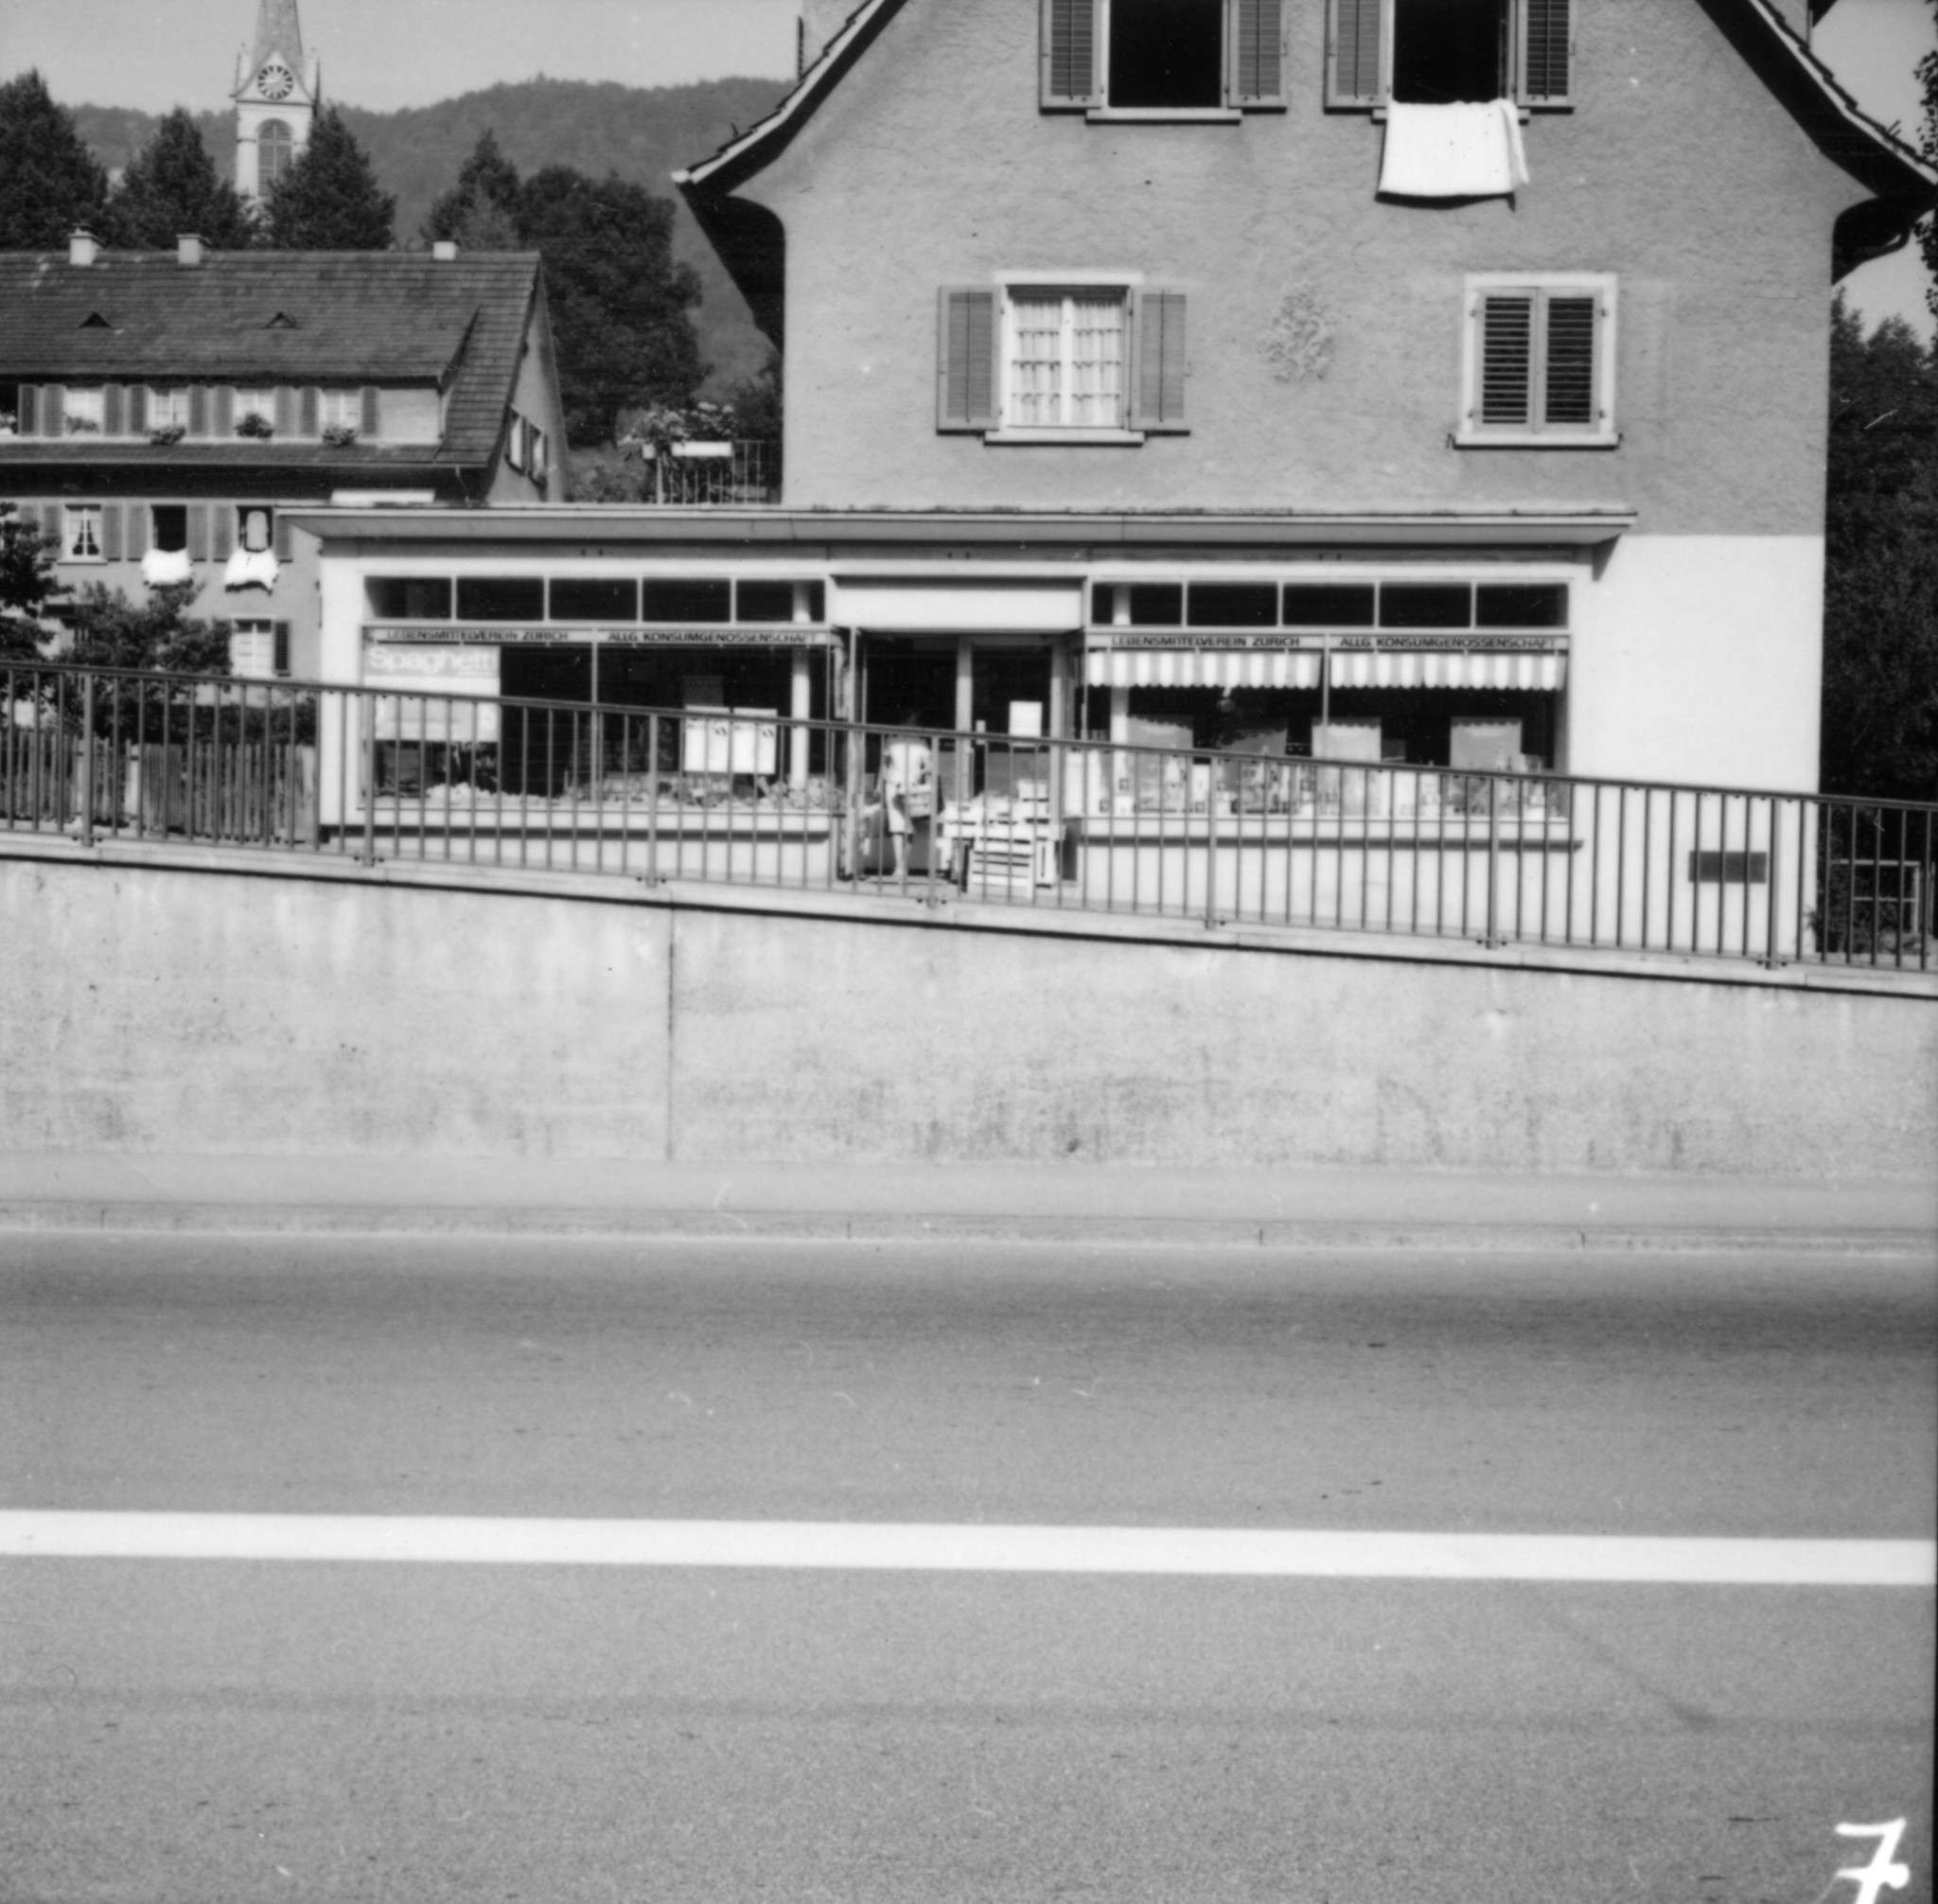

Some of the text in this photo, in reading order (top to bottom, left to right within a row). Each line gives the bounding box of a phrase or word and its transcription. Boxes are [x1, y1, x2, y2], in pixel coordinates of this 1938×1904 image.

[387, 628, 518, 641] LEBENSMITTELVEREIN
[643, 631, 816, 643] KONSUMGENOSSENSCHAFT
[1112, 635, 1246, 647] LEBENSMITTELVEREIN
[1376, 636, 1555, 649] KONSUMGENOSSENSCHAFT
[369, 646, 495, 674] Spaghetti
